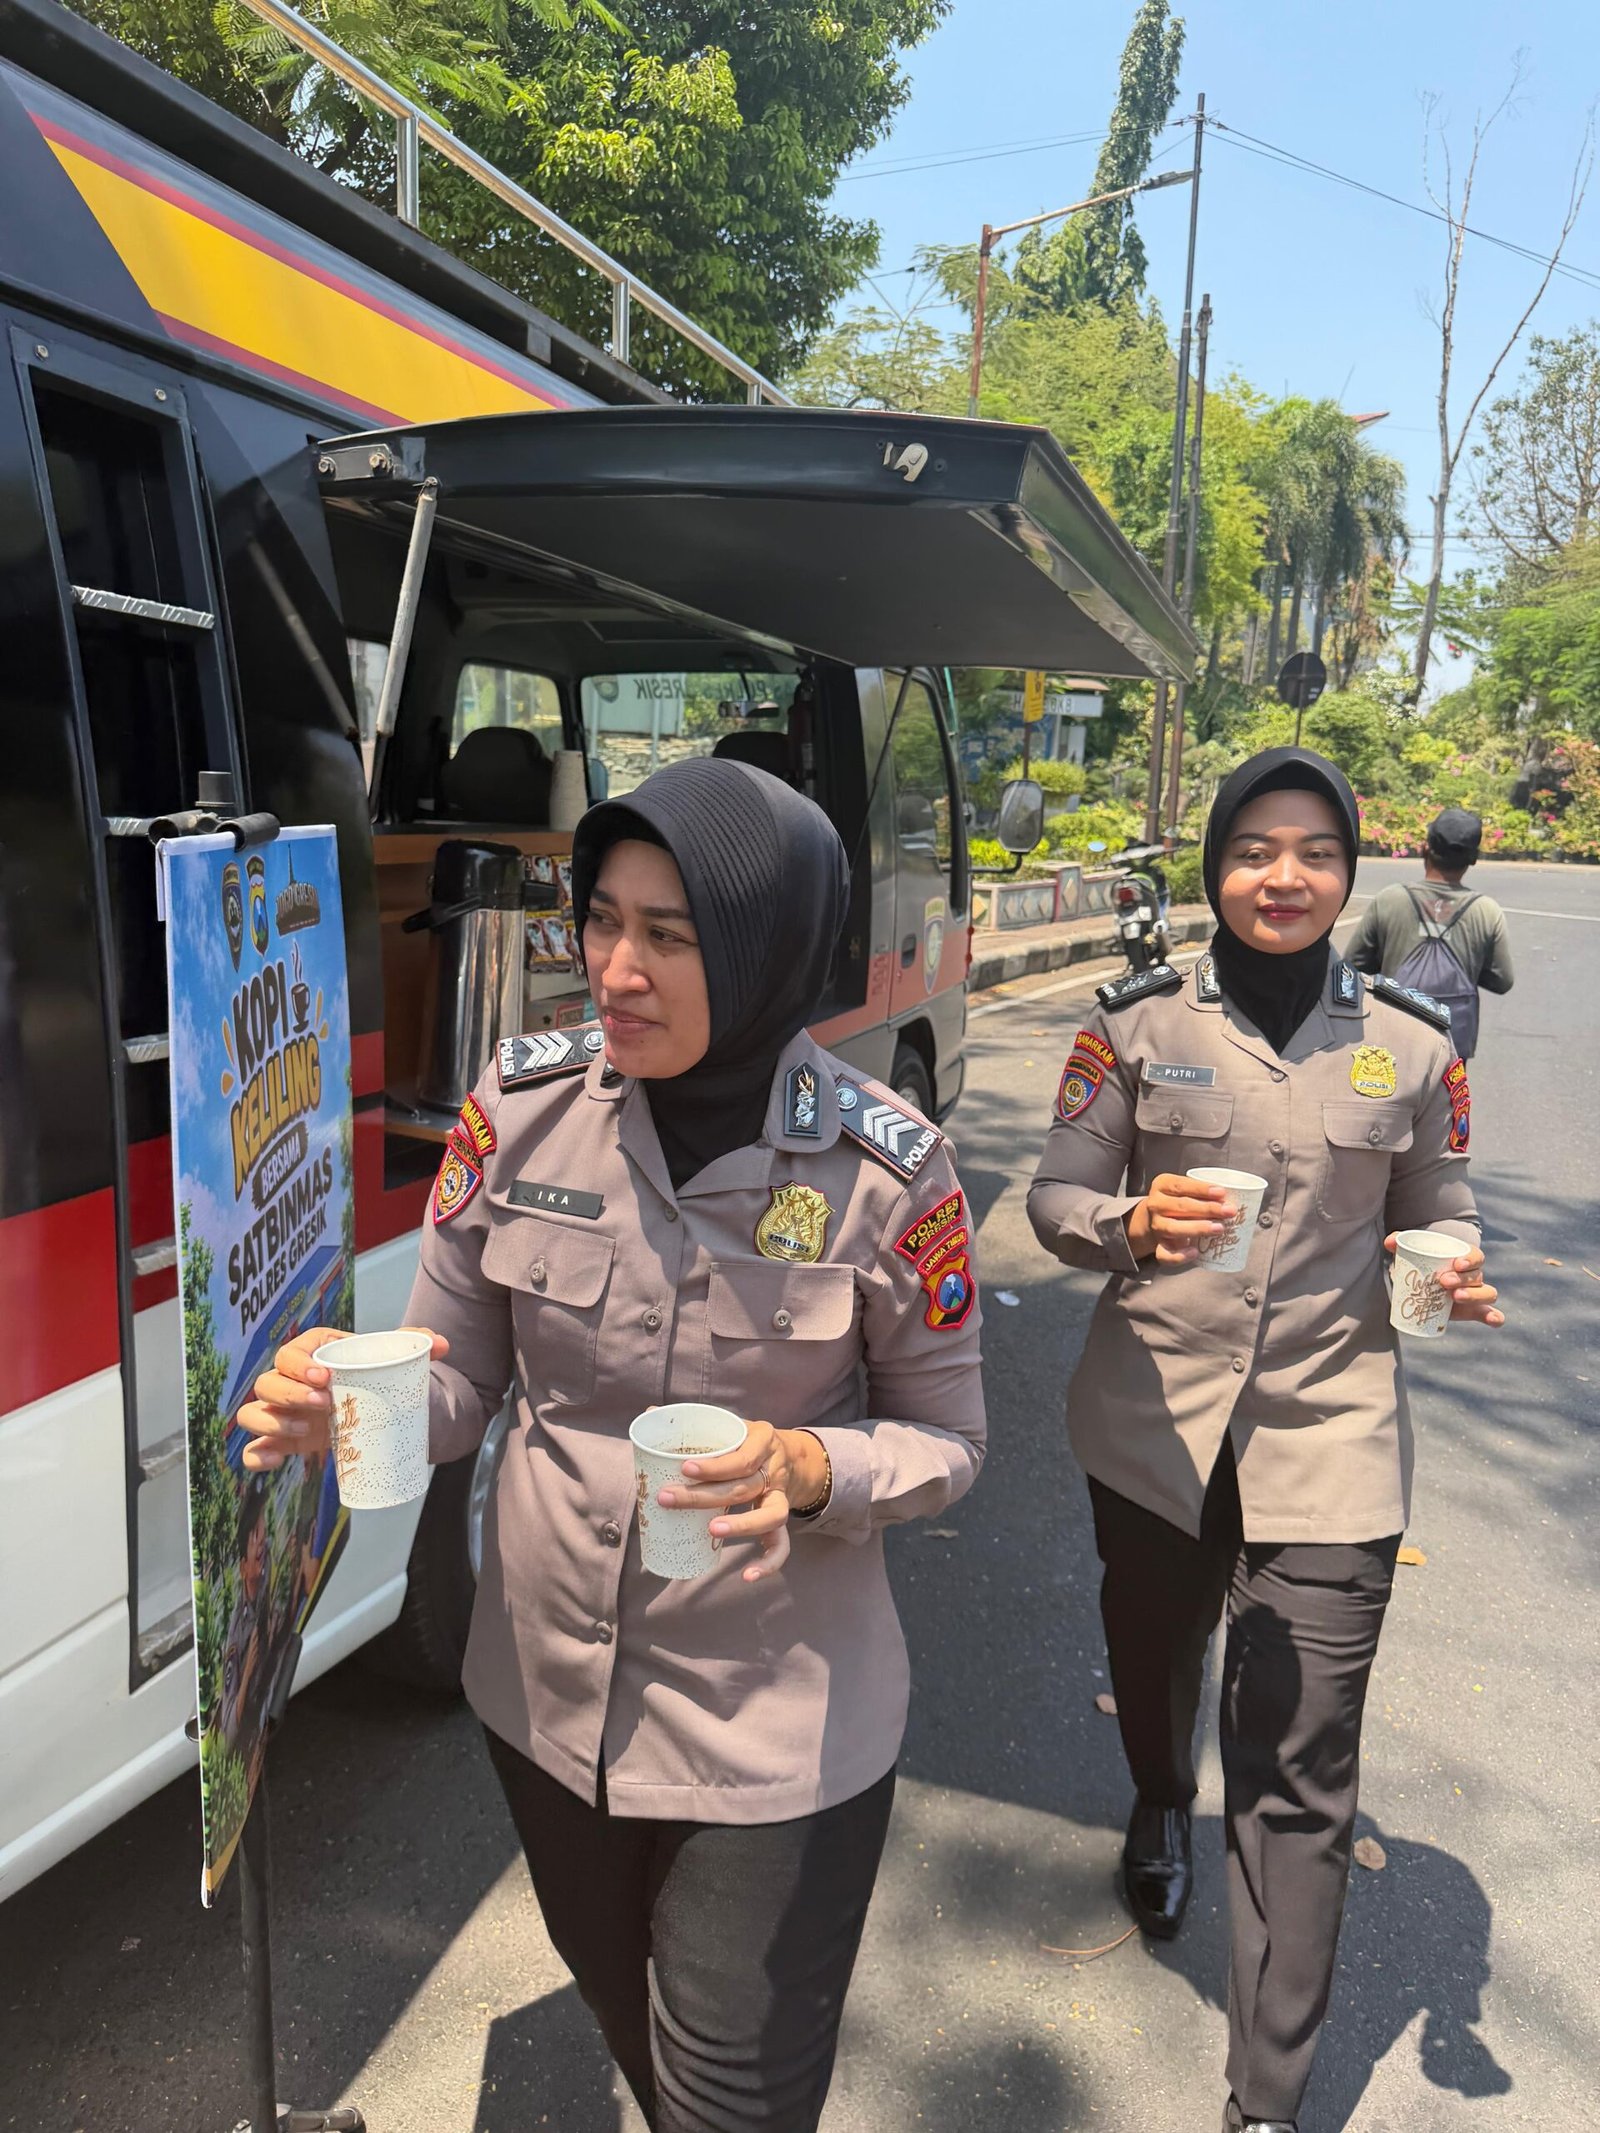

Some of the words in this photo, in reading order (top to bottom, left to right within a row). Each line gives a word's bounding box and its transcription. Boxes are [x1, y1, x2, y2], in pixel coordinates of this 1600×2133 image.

[233, 962, 288, 1083] KOPI
[500, 1037, 516, 1079] POLISI
[1164, 1068, 1196, 1079] PUTRI
[229, 1032, 321, 1202] KELILING
[261, 1138, 301, 1197] BERSAMA
[902, 1129, 938, 1172] POLISI
[537, 1190, 569, 1206] IKA
[229, 1146, 332, 1306] SATBINMAS
[769, 1233, 810, 1253] POLISI
[907, 1198, 959, 1249] POLRES
[918, 1212, 957, 1248] GRESIK
[240, 1254, 287, 1336] POLRES
[288, 1203, 327, 1274] GRESIK
[925, 1247, 947, 1271] JAWA
[1401, 1296, 1446, 1327] Coffee
